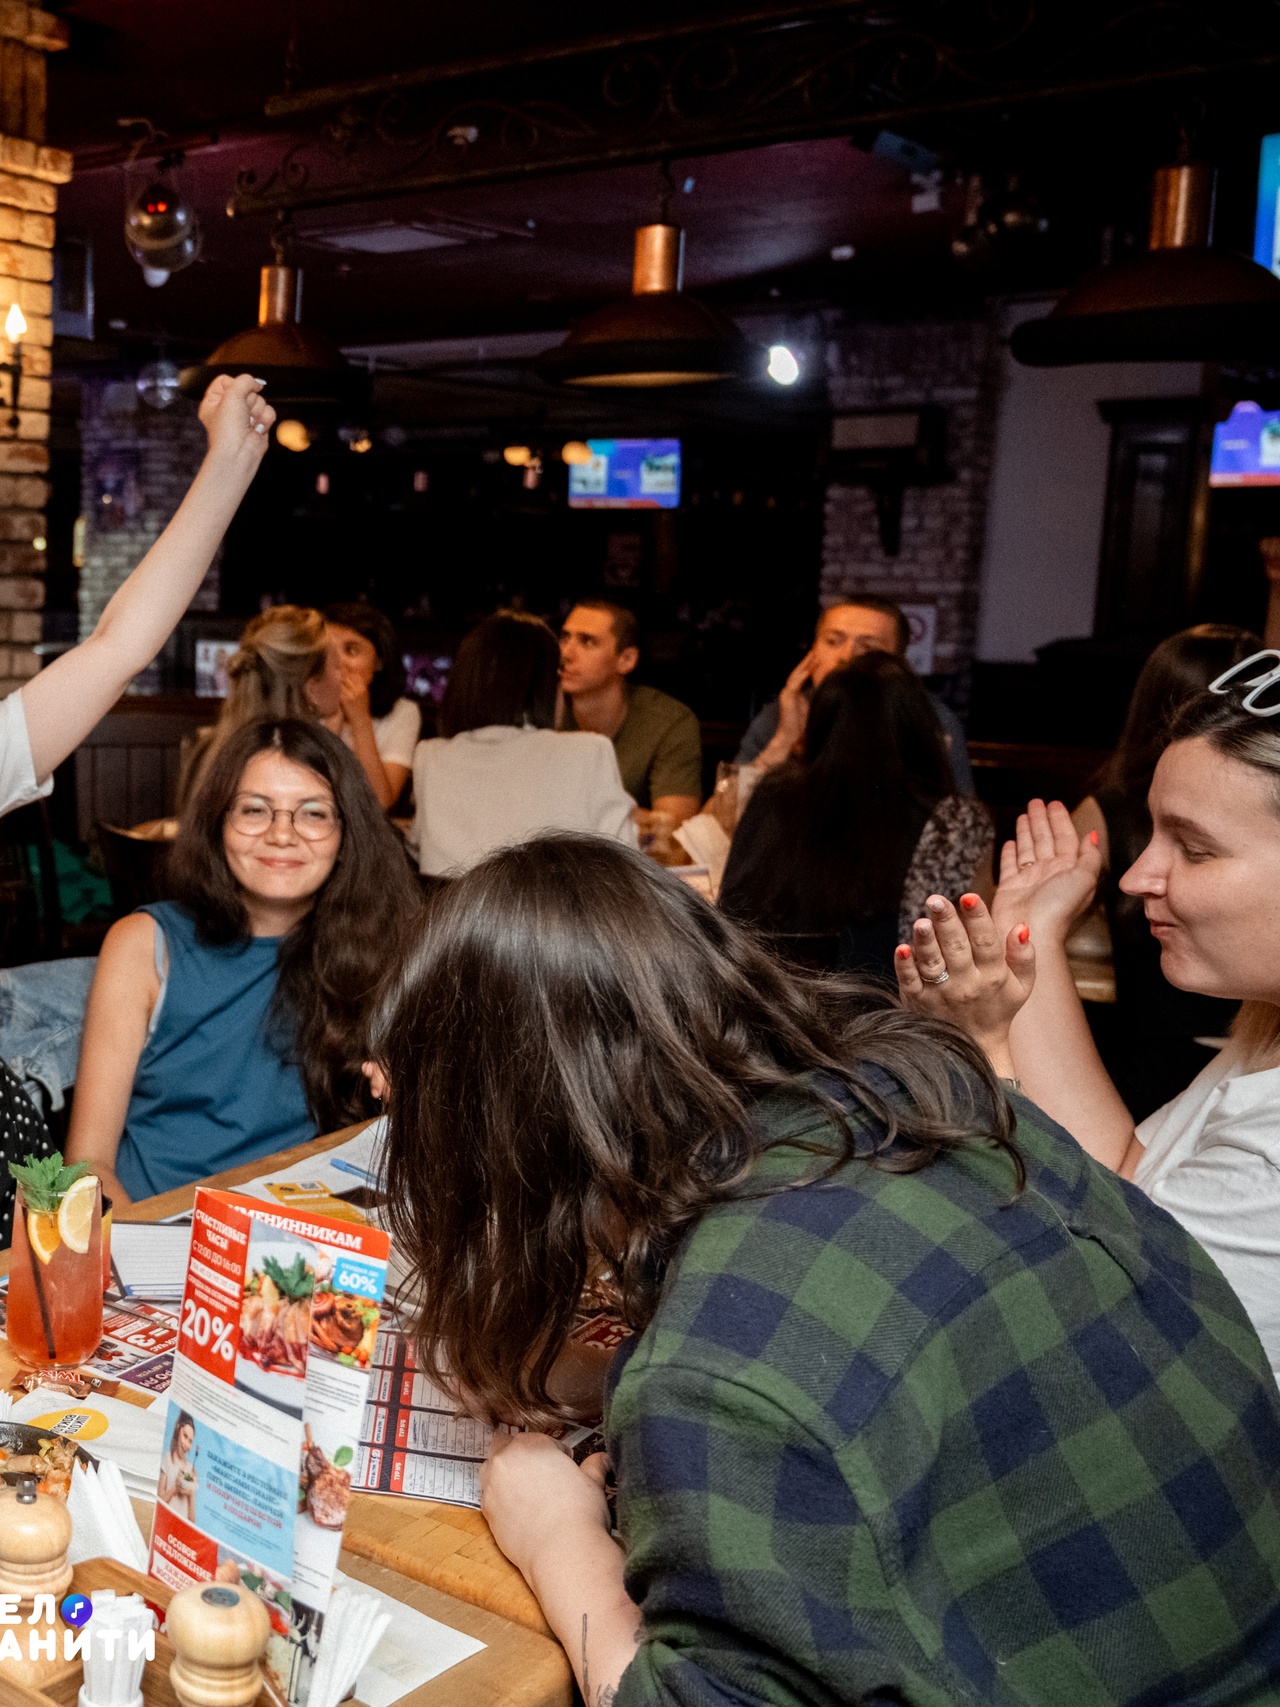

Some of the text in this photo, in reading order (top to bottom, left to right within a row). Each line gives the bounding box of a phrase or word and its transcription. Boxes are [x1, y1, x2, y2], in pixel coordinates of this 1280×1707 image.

[195, 1208, 247, 1245] СЧАСТЛИВЫЕ
[206, 1228, 229, 1250] ЧАСЫ
[227, 1203, 362, 1250] МЕНИННИКАМ
[338, 1270, 378, 1295] 60%
[181, 1298, 235, 1362] 20%
[38, 1369, 85, 1386] Twix
[154, 1533, 214, 1582] ПРЕДЛОЖЕНИЕ
[167, 1533, 197, 1562] ОСОБОЕ
